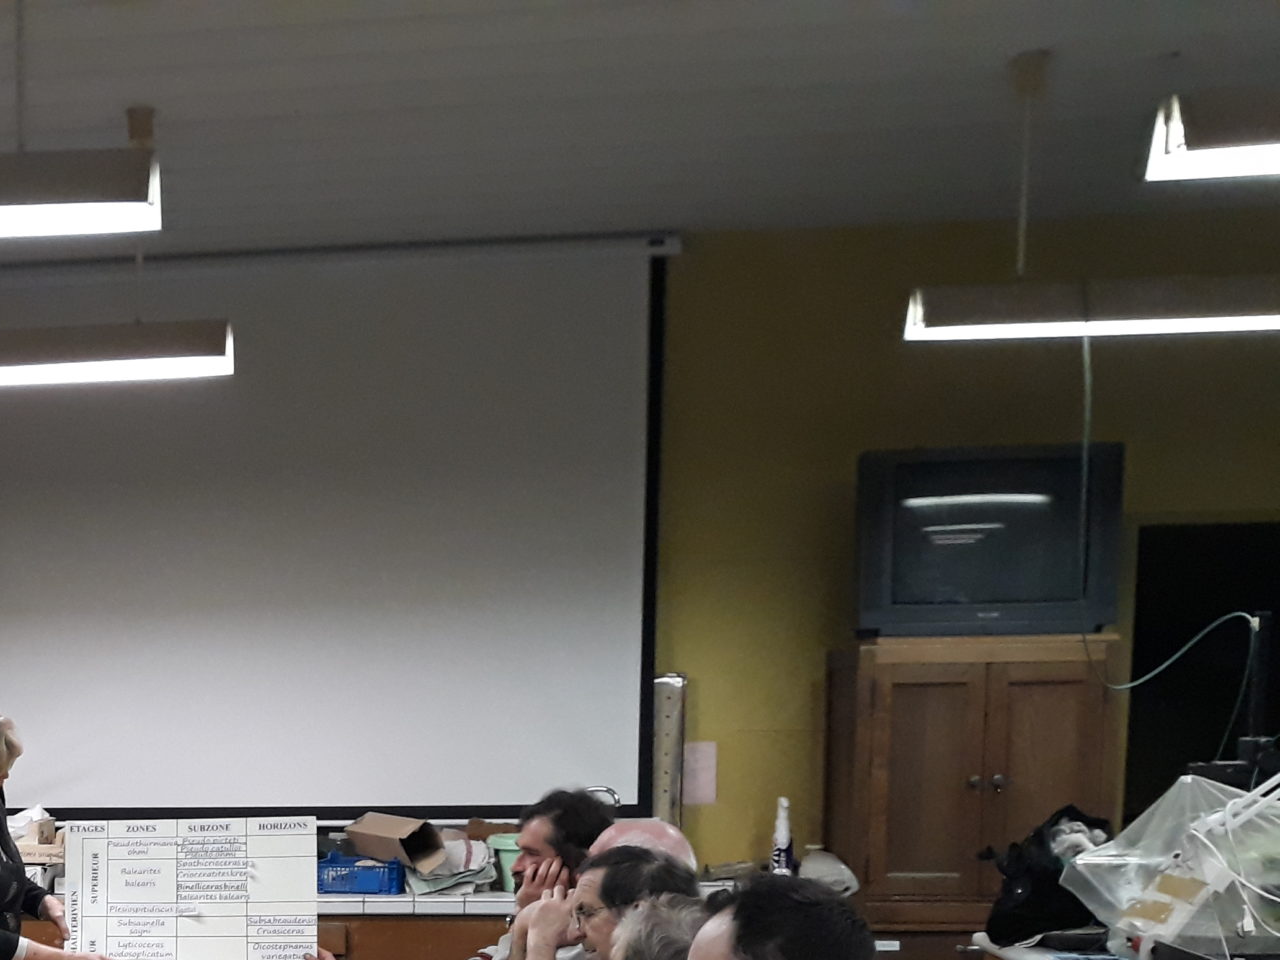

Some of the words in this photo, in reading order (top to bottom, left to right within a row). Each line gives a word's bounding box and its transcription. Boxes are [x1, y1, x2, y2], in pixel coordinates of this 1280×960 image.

[70, 824, 105, 833] ETAGES
[126, 824, 157, 833] ZONES
[187, 823, 231, 833] SUBZONE
[258, 821, 308, 831] HORIZONS
[90, 852, 99, 904] SUPERIEUR
